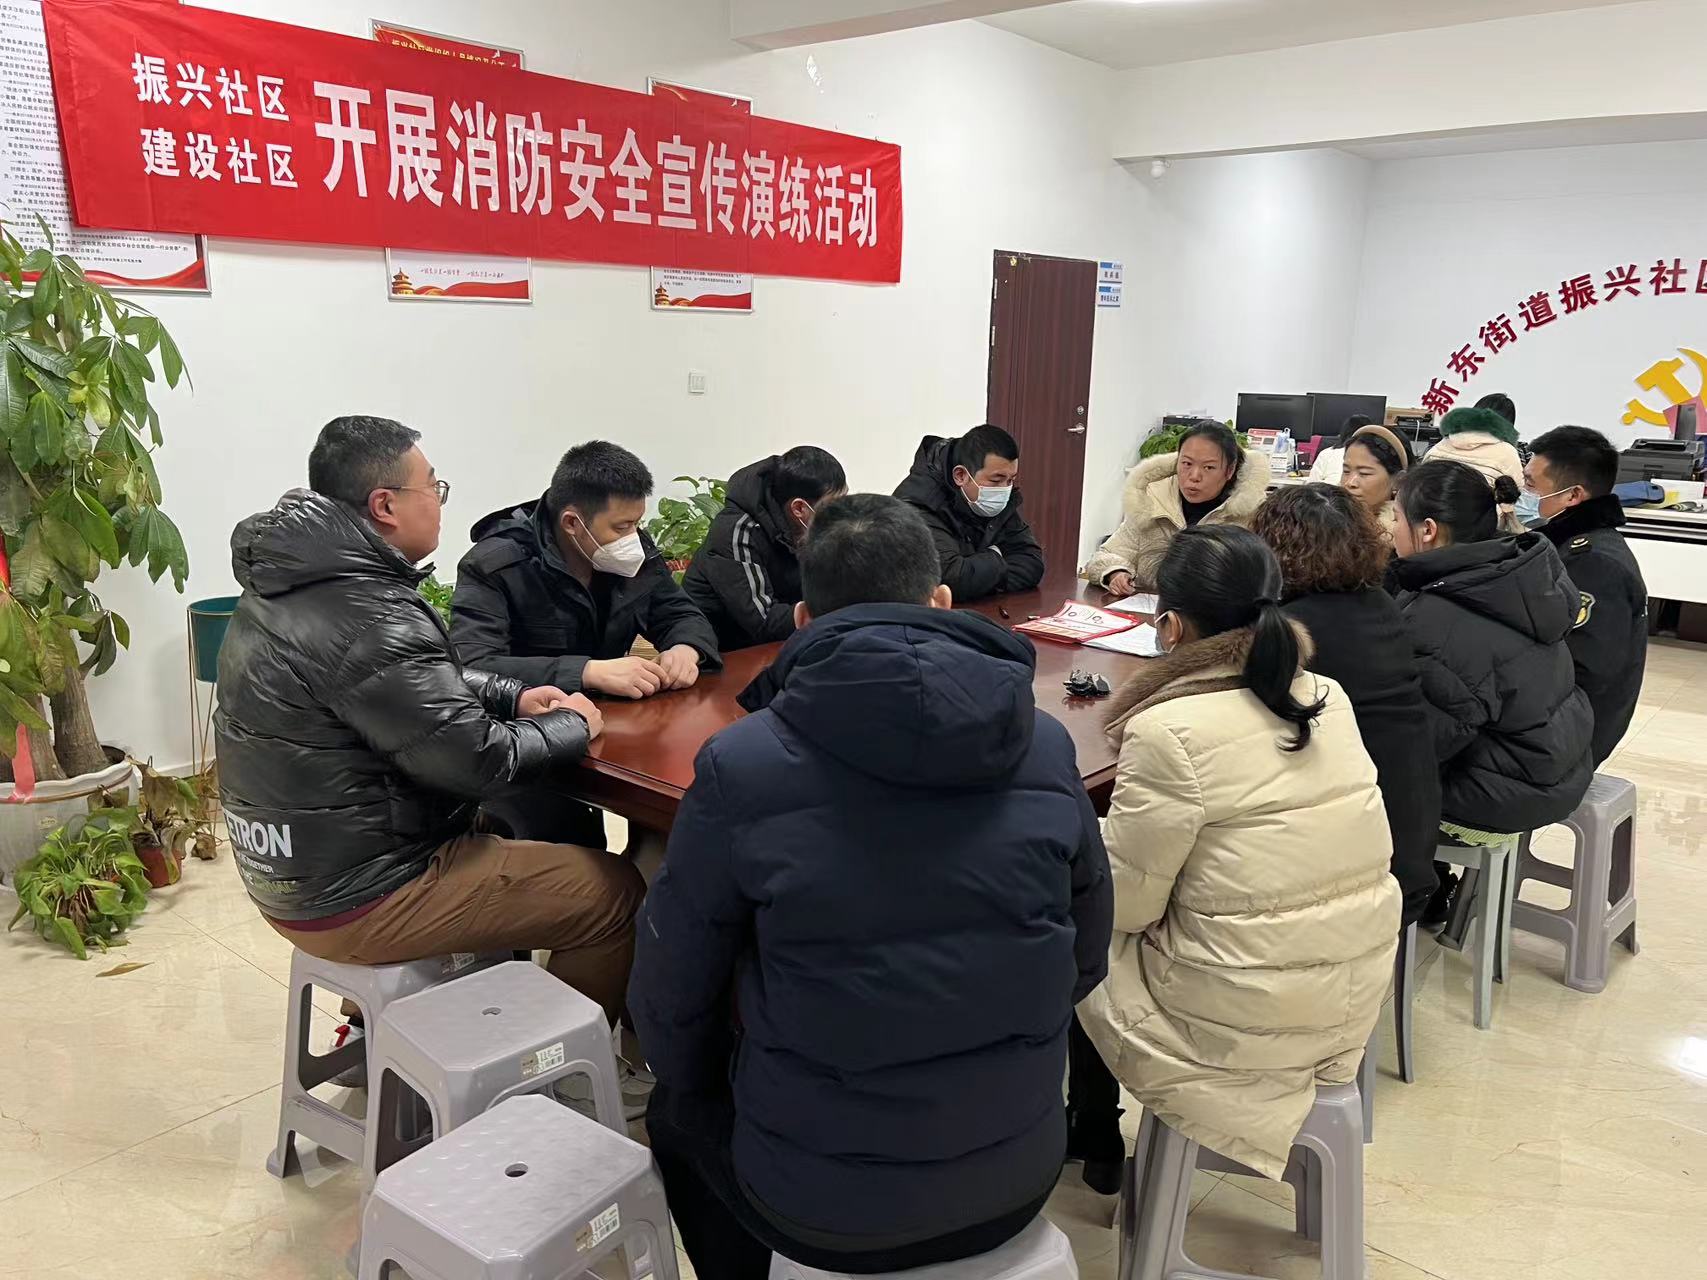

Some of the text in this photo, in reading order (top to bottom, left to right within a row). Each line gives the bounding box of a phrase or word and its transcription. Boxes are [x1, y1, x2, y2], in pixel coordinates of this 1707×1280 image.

[131, 52, 290, 122] 振兴社区
[139, 127, 299, 188] 建设社区
[313, 80, 878, 249] 开展消防安全宣传演练活动
